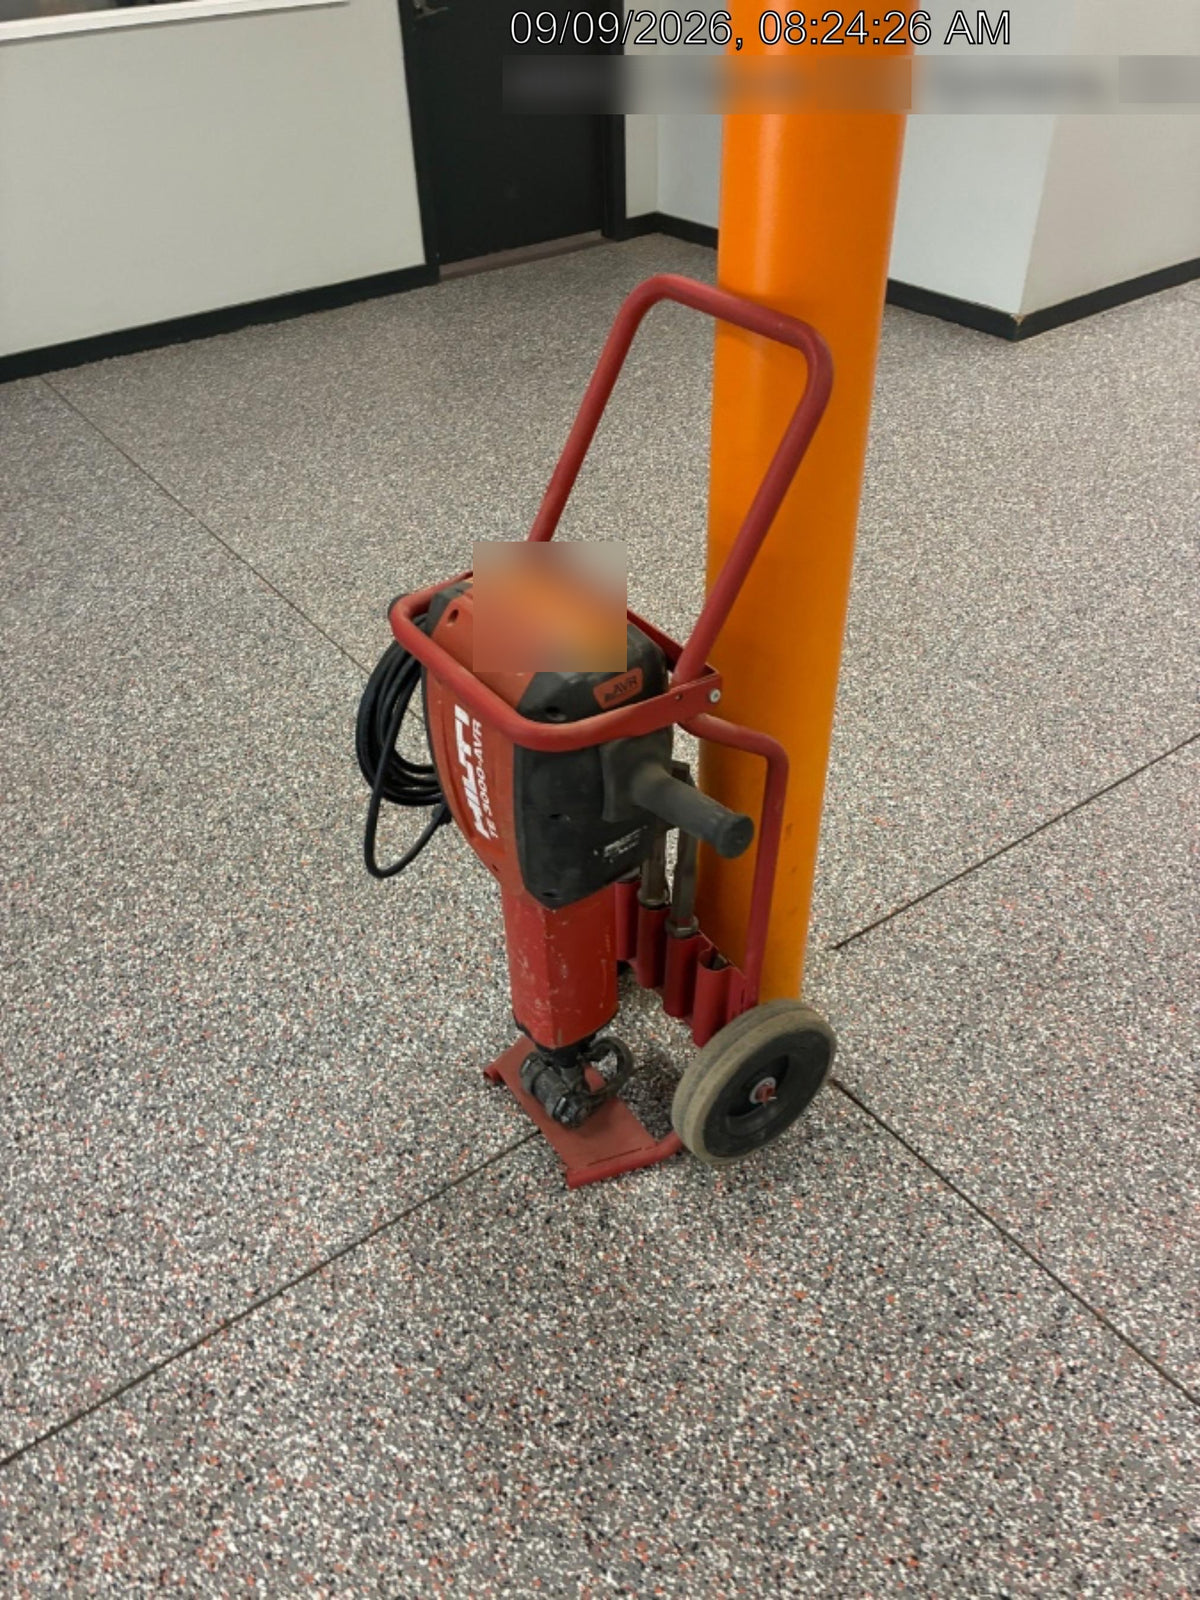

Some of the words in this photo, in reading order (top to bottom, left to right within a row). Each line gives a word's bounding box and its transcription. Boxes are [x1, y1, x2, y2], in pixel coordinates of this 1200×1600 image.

[613, 675, 637, 695] AVR
[455, 704, 491, 840] HILTI
[473, 717, 493, 817] 3000-AVR
[485, 816, 498, 838] TE
